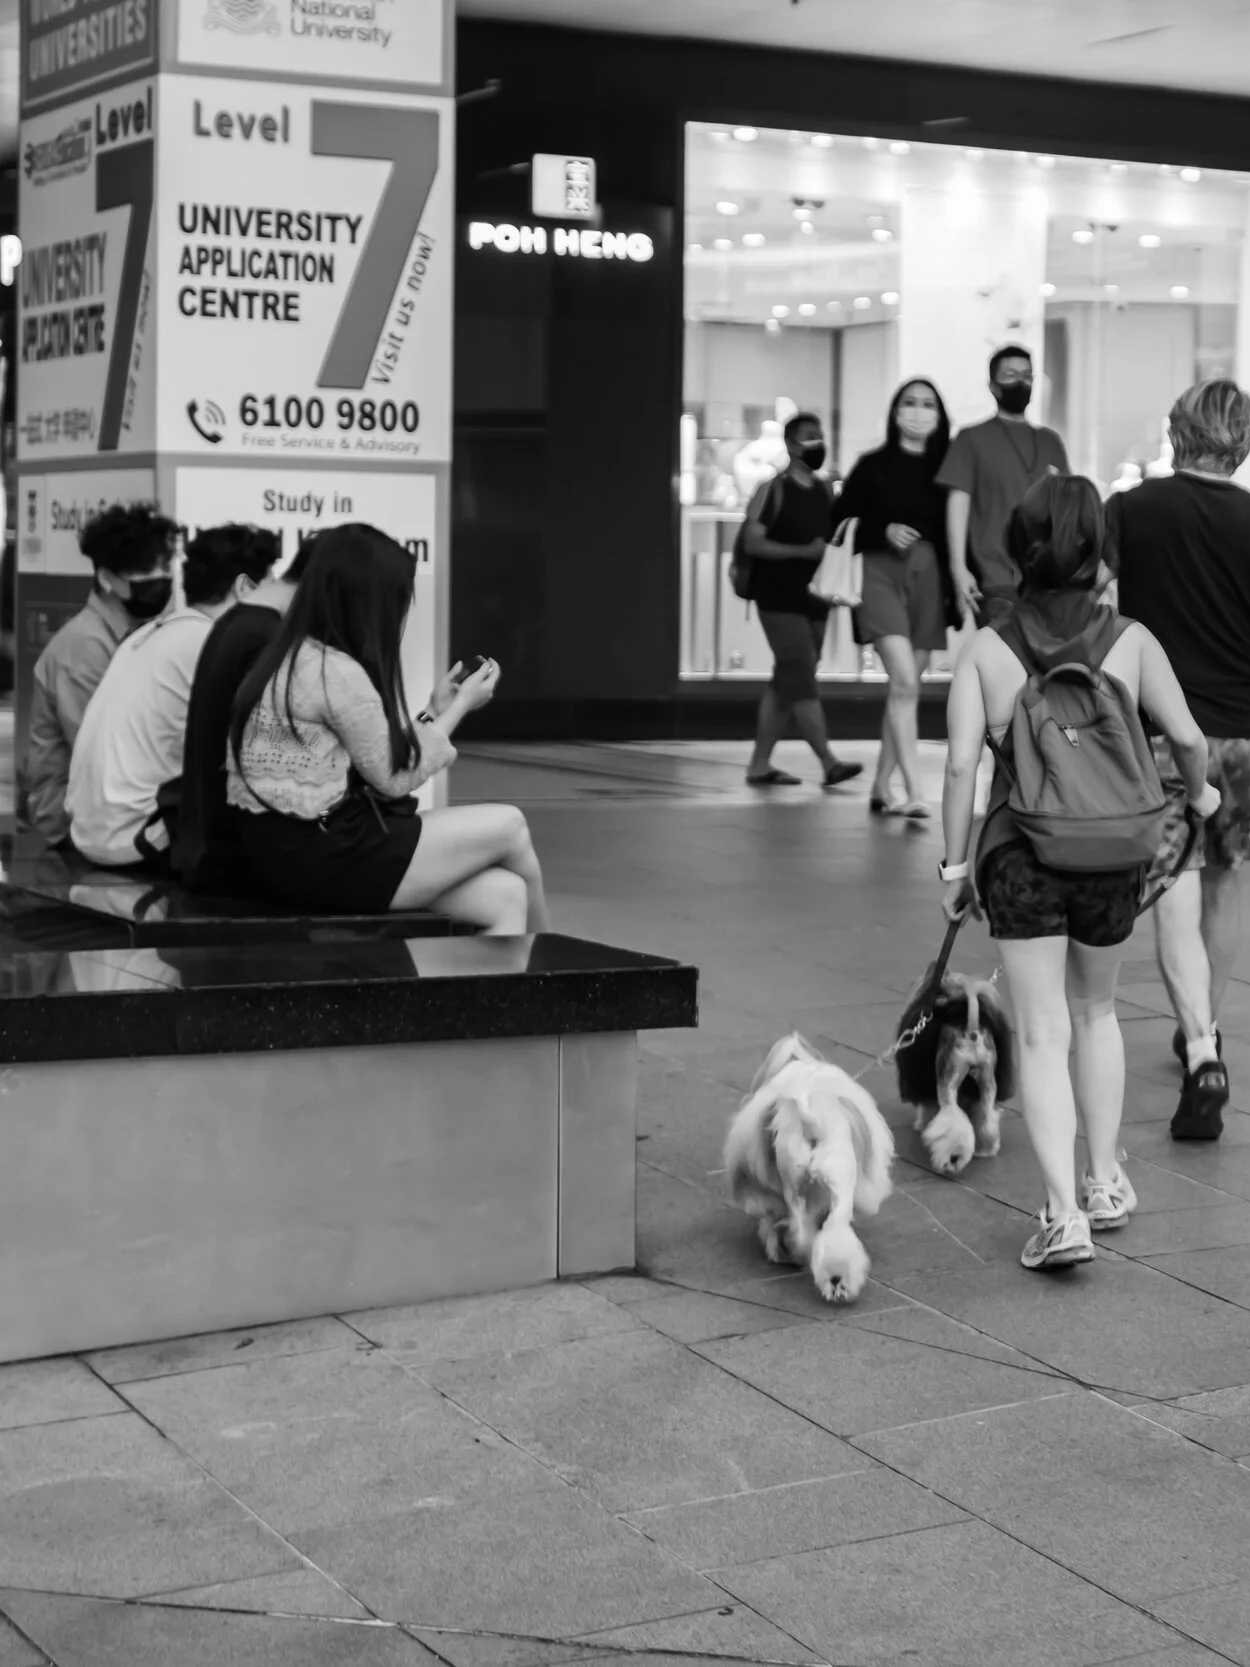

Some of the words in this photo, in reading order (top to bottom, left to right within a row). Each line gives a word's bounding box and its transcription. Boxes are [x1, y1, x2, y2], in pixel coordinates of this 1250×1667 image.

[291, 0, 376, 21] National
[290, 17, 392, 48] University
[96, 86, 152, 146] Level
[178, 202, 363, 244] UNIVERSITY
[468, 221, 547, 255] POH
[553, 227, 655, 262] HENG
[178, 244, 335, 283] APPLICATION
[193, 98, 290, 143] Level
[309, 98, 440, 391] 7
[178, 285, 301, 322] CENTRE
[371, 331, 404, 384] Visit
[396, 298, 416, 328] us
[238, 392, 325, 430] 6100
[336, 398, 421, 433] 9800
[241, 433, 276, 447] Free
[280, 433, 335, 450] Service
[339, 436, 351, 450] &
[355, 437, 421, 455] Advisory
[262, 488, 325, 518] Study
[333, 490, 354, 514] in
